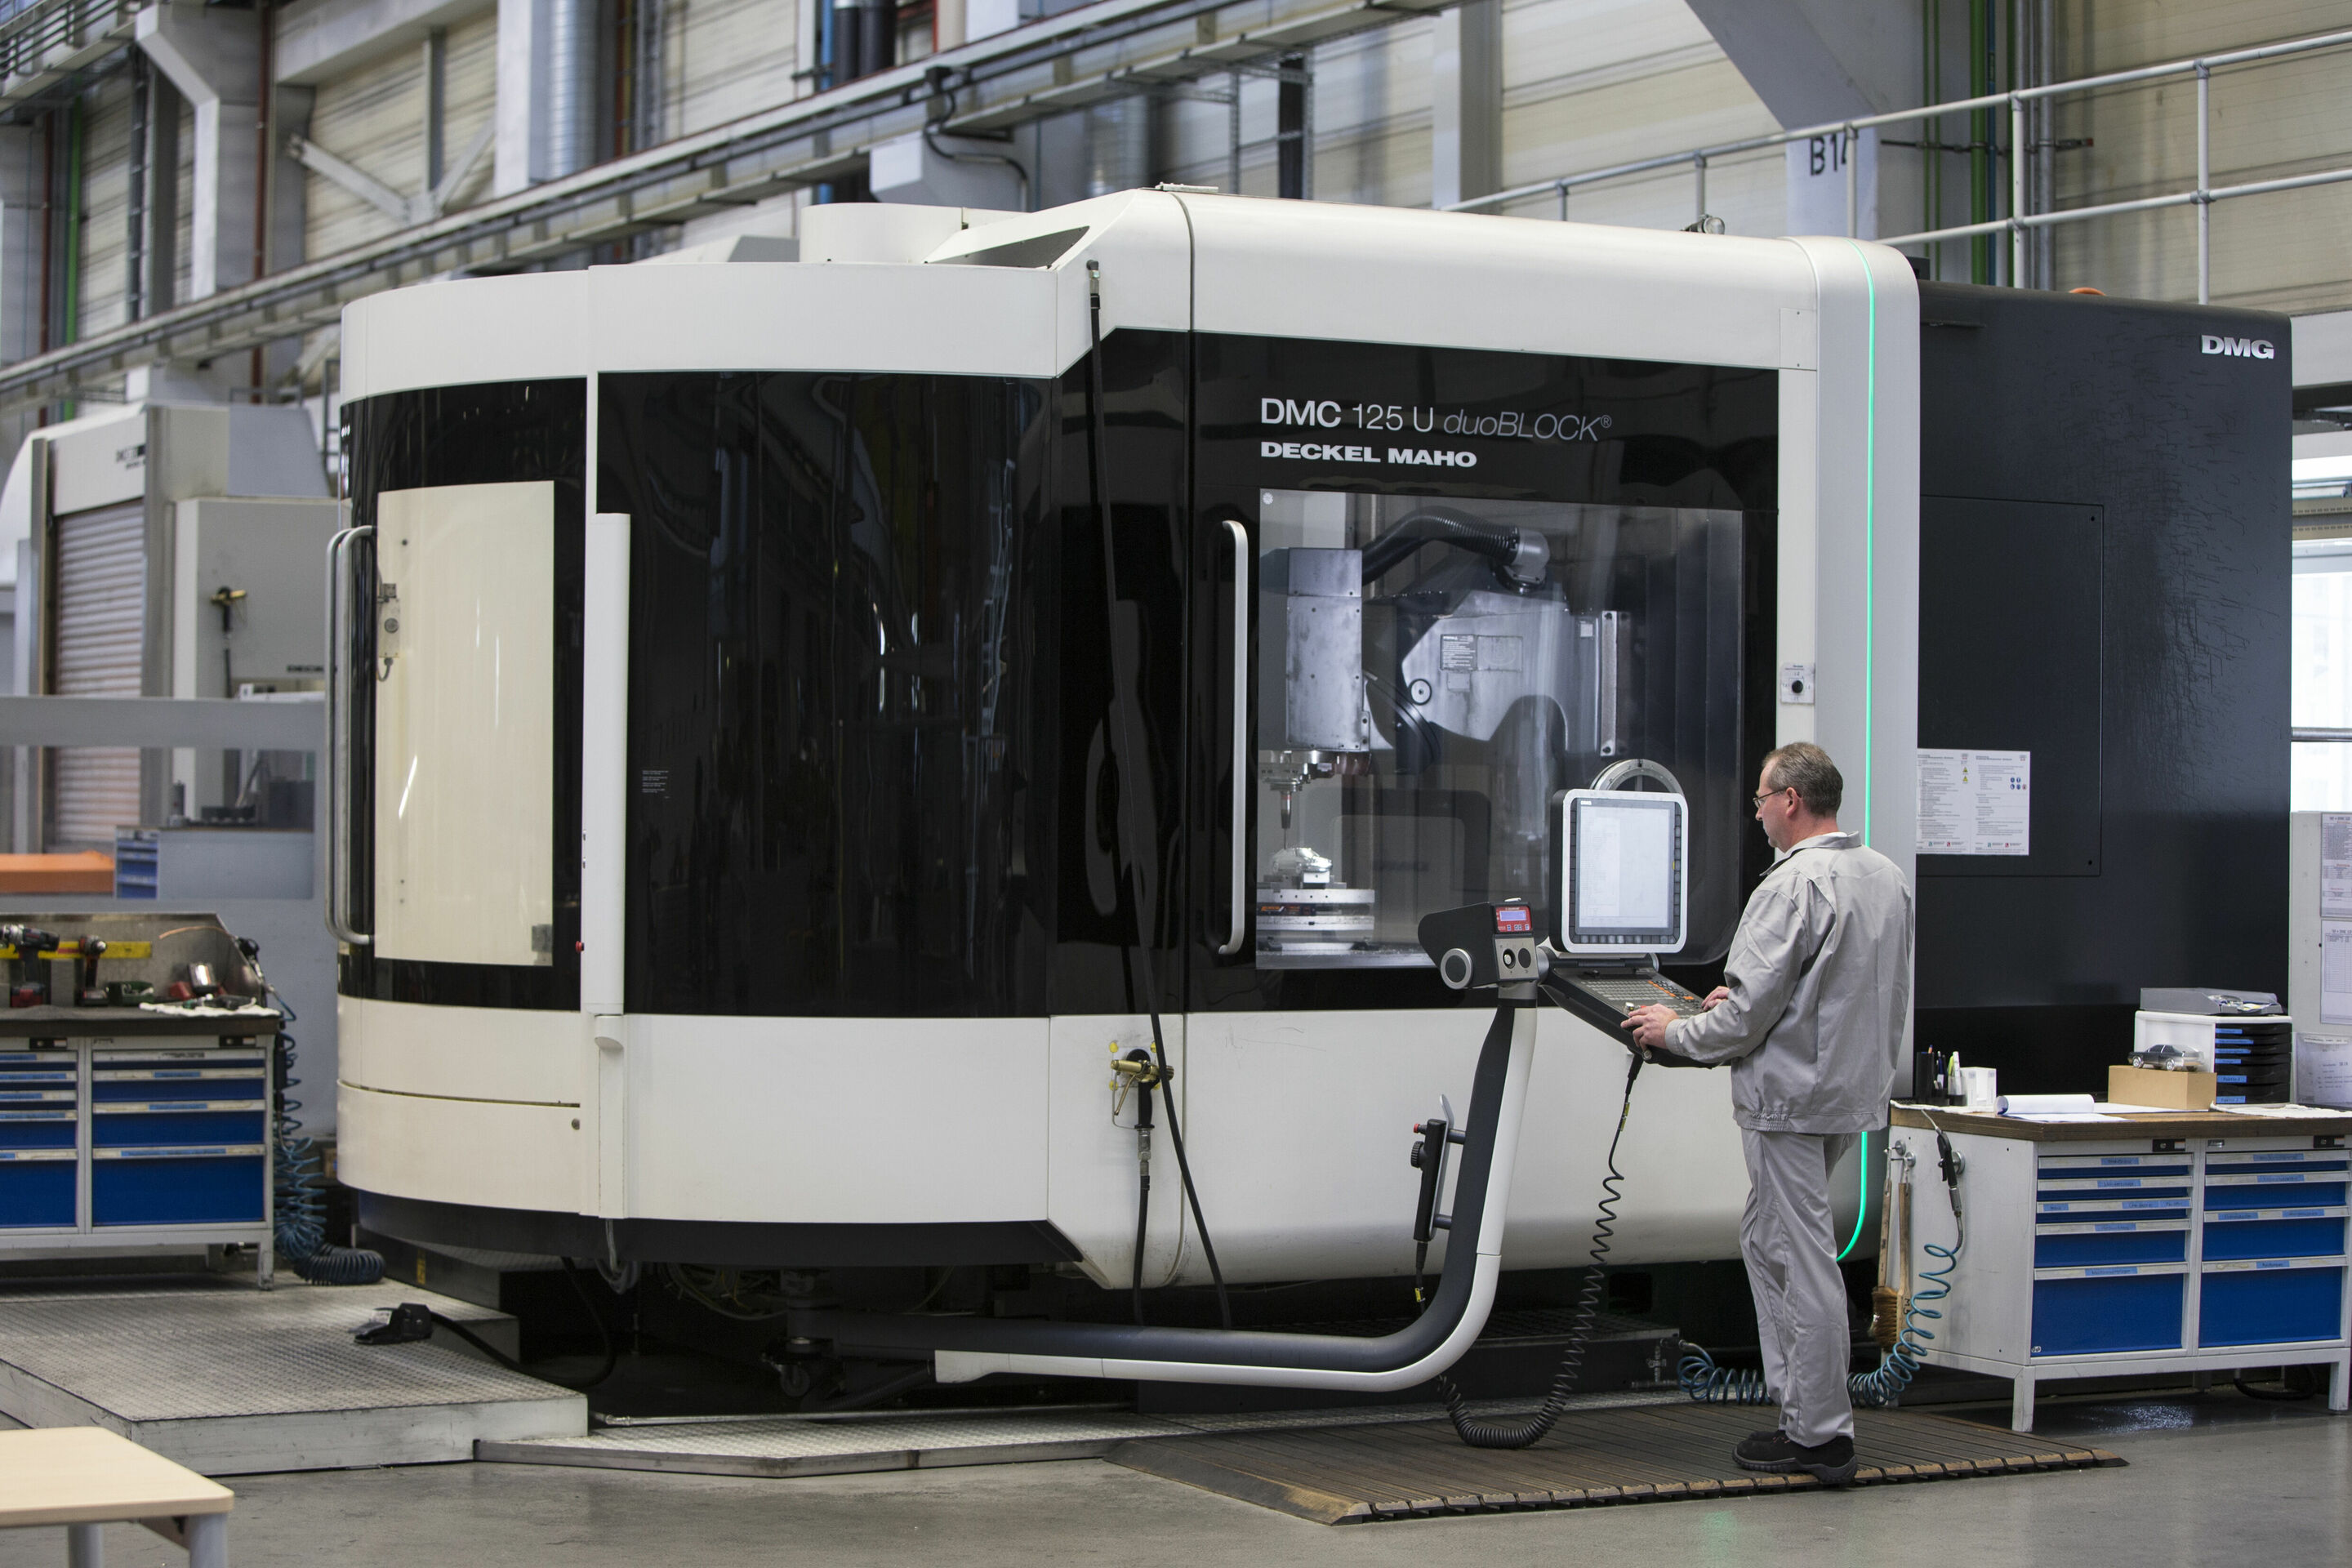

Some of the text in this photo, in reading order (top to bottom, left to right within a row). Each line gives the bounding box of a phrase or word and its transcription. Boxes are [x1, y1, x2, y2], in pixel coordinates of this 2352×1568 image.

[2202, 335, 2274, 359] DMG
[1262, 398, 1341, 427] DMC
[1352, 404, 1403, 430] 125
[1414, 407, 1433, 432] U
[1261, 442, 1477, 467] DECKEL MAHO
